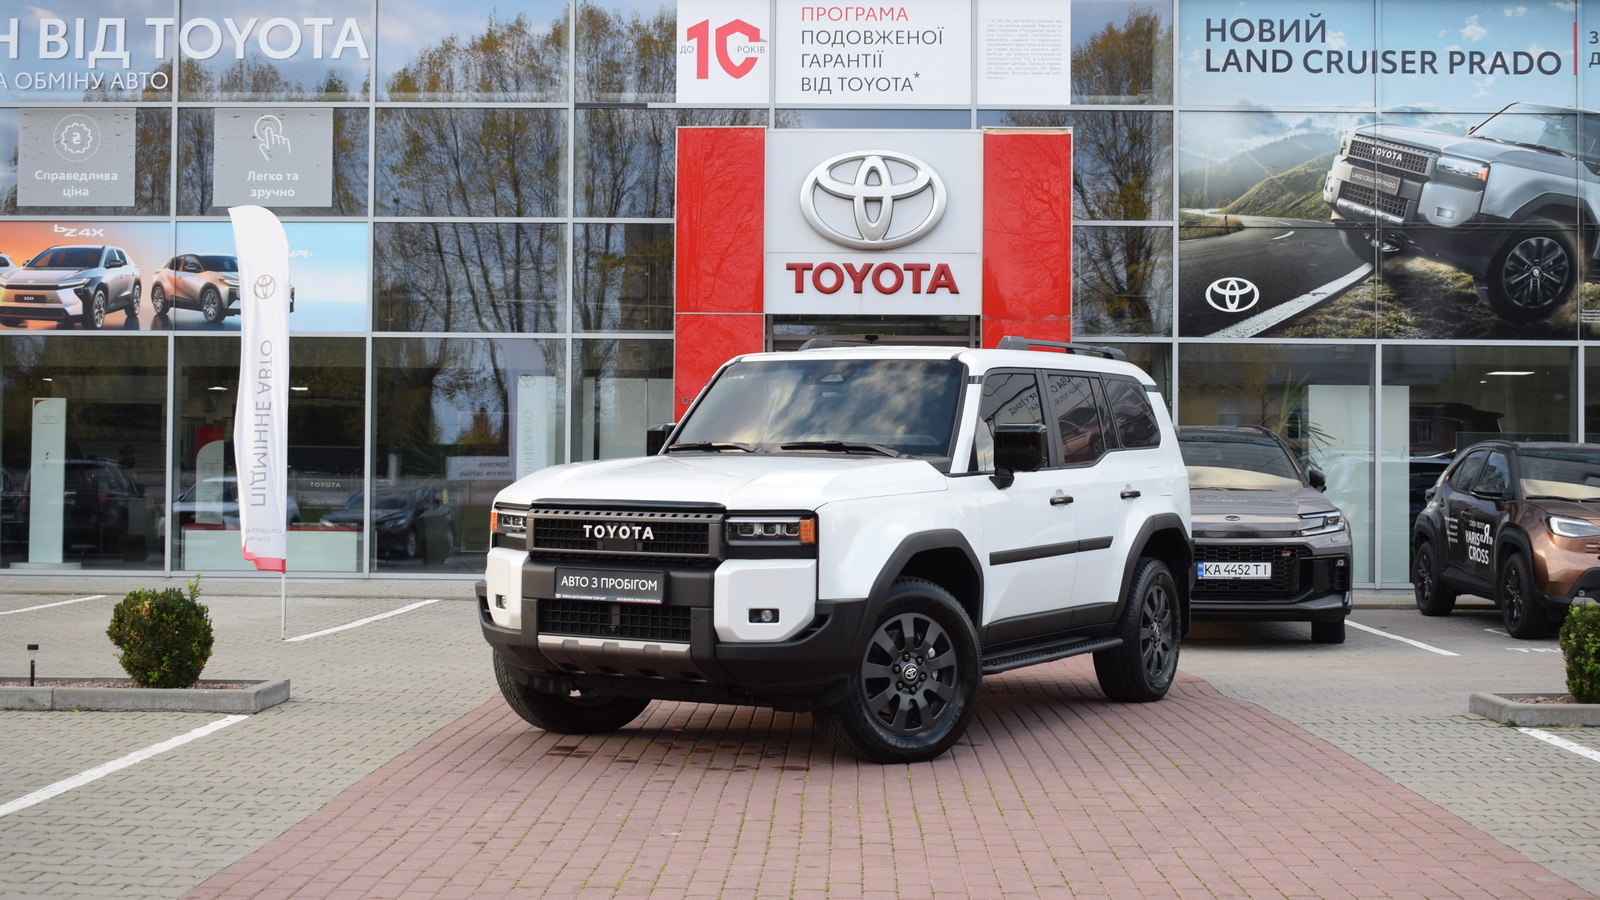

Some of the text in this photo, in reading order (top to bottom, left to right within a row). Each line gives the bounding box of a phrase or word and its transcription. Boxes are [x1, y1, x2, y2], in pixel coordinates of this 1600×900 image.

[801, 7, 909, 22] ПРОГРАМА
[1205, 13, 1327, 44] НОВИЙ
[39, 17, 131, 69] ВІД
[146, 17, 370, 60] TOYOTA
[801, 27, 943, 48] ПОДОВЖЕНОЇ
[680, 45, 766, 55] ДО РОКІВ
[801, 50, 883, 69] ГАРАНТІЇ
[1205, 49, 1562, 76] LAND CRUISER PRADO
[15, 71, 104, 90] ОБМІНУ
[111, 71, 170, 91] АВТО
[801, 77, 832, 95] ВІД
[1370, 147, 1403, 161] TOYOTA
[35, 170, 119, 183] Справедлива
[246, 171, 300, 183] Легко та
[62, 186, 90, 198] ціна
[250, 187, 296, 199] зручно
[53, 224, 105, 238] bZ4X
[786, 262, 960, 295] TOYOTA
[583, 525, 655, 540] TOYOTA
[1465, 530, 1480, 546] YARIS
[1468, 545, 1489, 565] CROSS
[1204, 564, 1221, 575] KA
[1223, 564, 1251, 575] 4452
[561, 575, 658, 591] АВТО З ПРОБІГОМ
